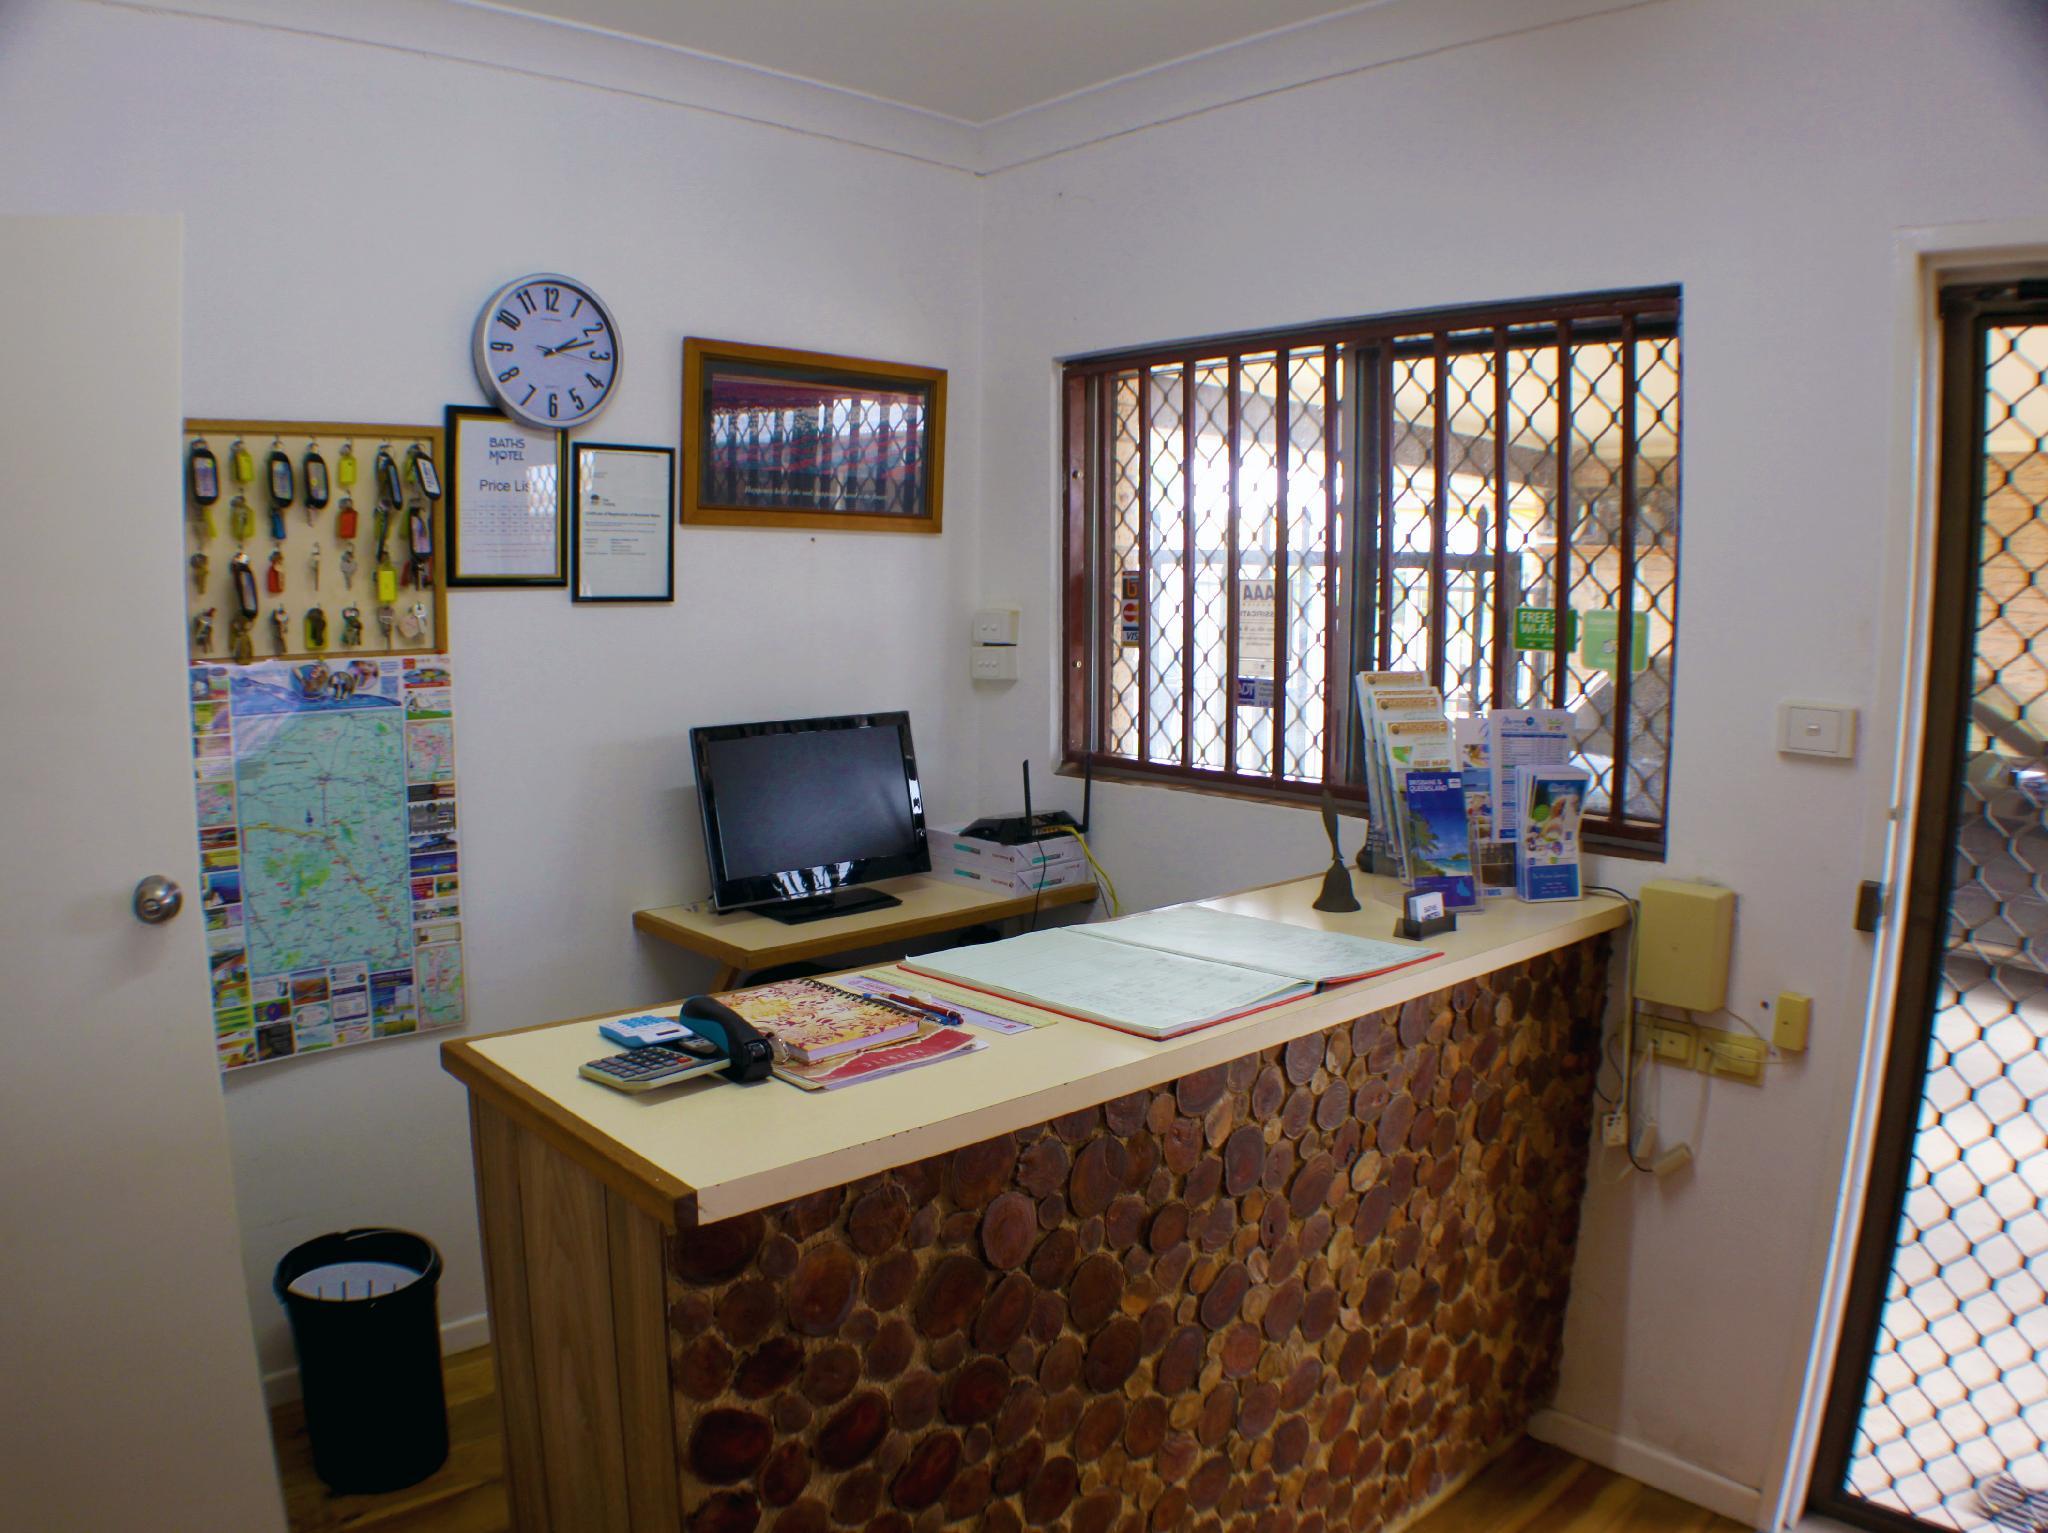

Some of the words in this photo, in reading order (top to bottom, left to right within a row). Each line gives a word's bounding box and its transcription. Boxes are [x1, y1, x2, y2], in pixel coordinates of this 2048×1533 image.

[516, 289, 538, 315] 11
[544, 287, 560, 312] 12
[570, 298, 583, 318] 1
[497, 309, 521, 331] 10
[583, 322, 604, 337] 2
[490, 341, 514, 352] 9
[589, 351, 611, 361] 3
[498, 367, 520, 383] 8
[585, 373, 604, 388] 4
[520, 384, 537, 406] 7
[568, 388, 584, 410] 5
[549, 394, 558, 418] 6
[489, 437, 525, 449] BATHS
[489, 450, 525, 463] MOTEL
[480, 480, 511, 492] Price
[515, 480, 530, 492] Lis
[1521, 611, 1550, 622] FREE
[1126, 632, 1139, 641] VIS
[1409, 785, 1448, 793] QUEENSLAND
